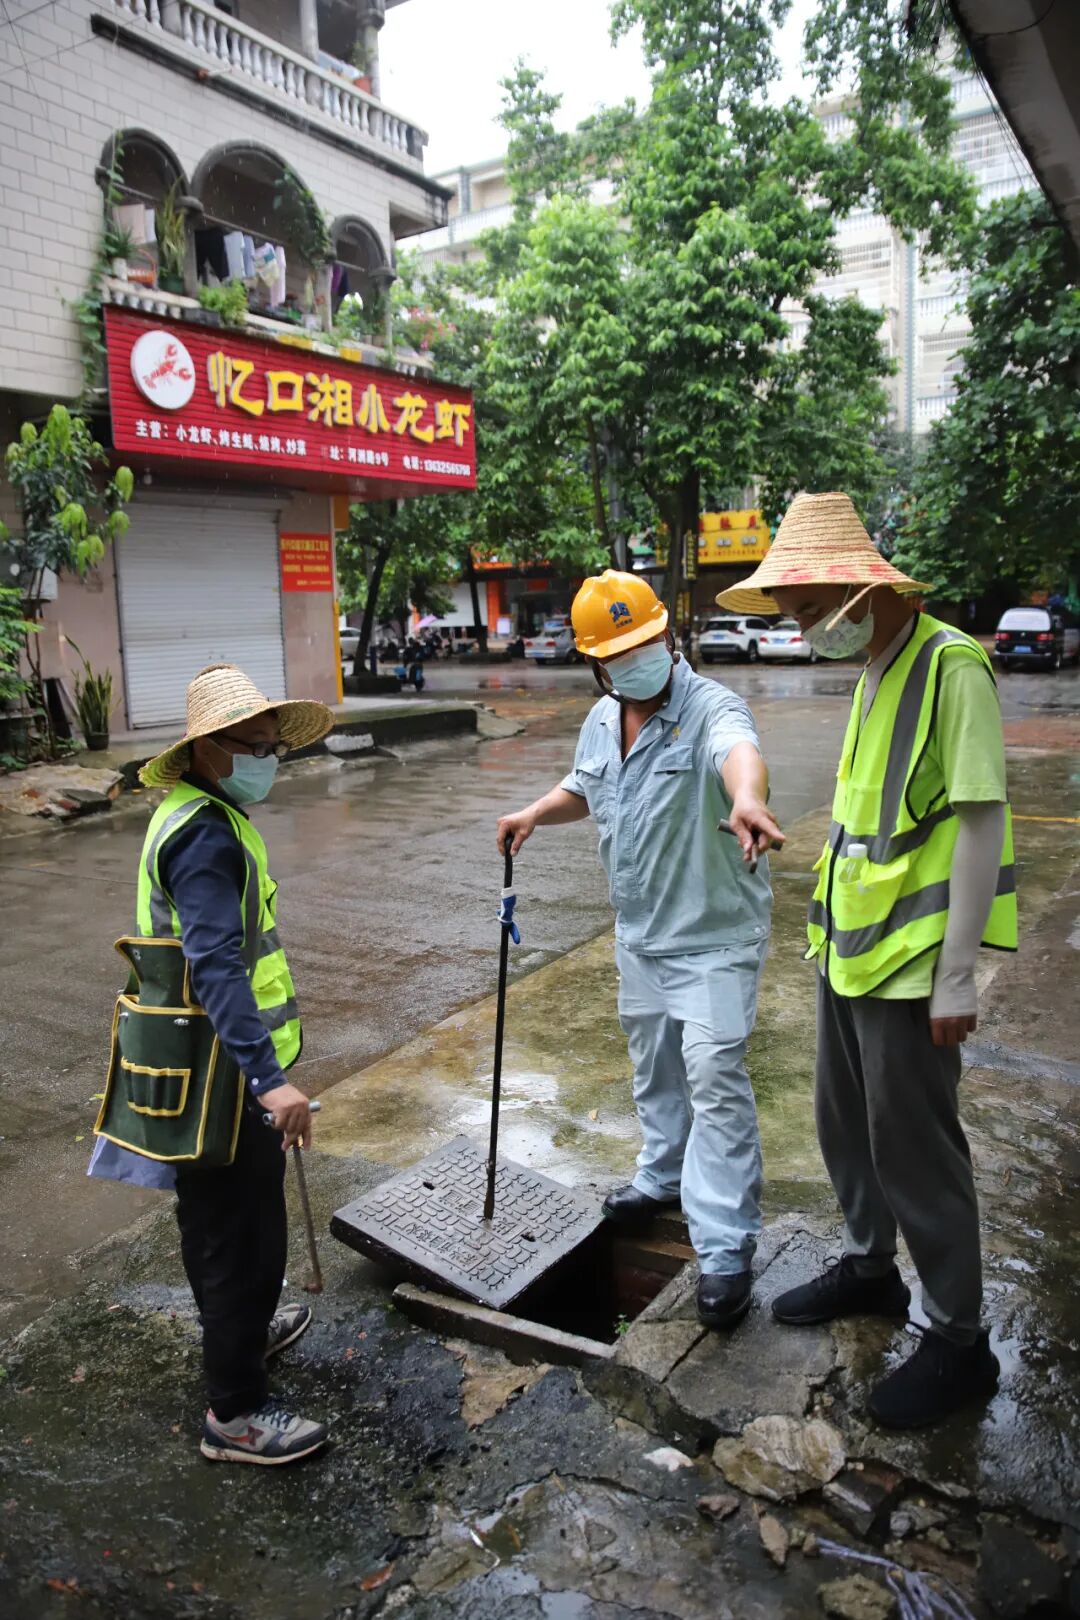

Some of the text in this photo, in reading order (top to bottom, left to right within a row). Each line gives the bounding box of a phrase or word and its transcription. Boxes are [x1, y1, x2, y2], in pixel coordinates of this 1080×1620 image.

[207, 351, 472, 447] 忆口湘小龙虾
